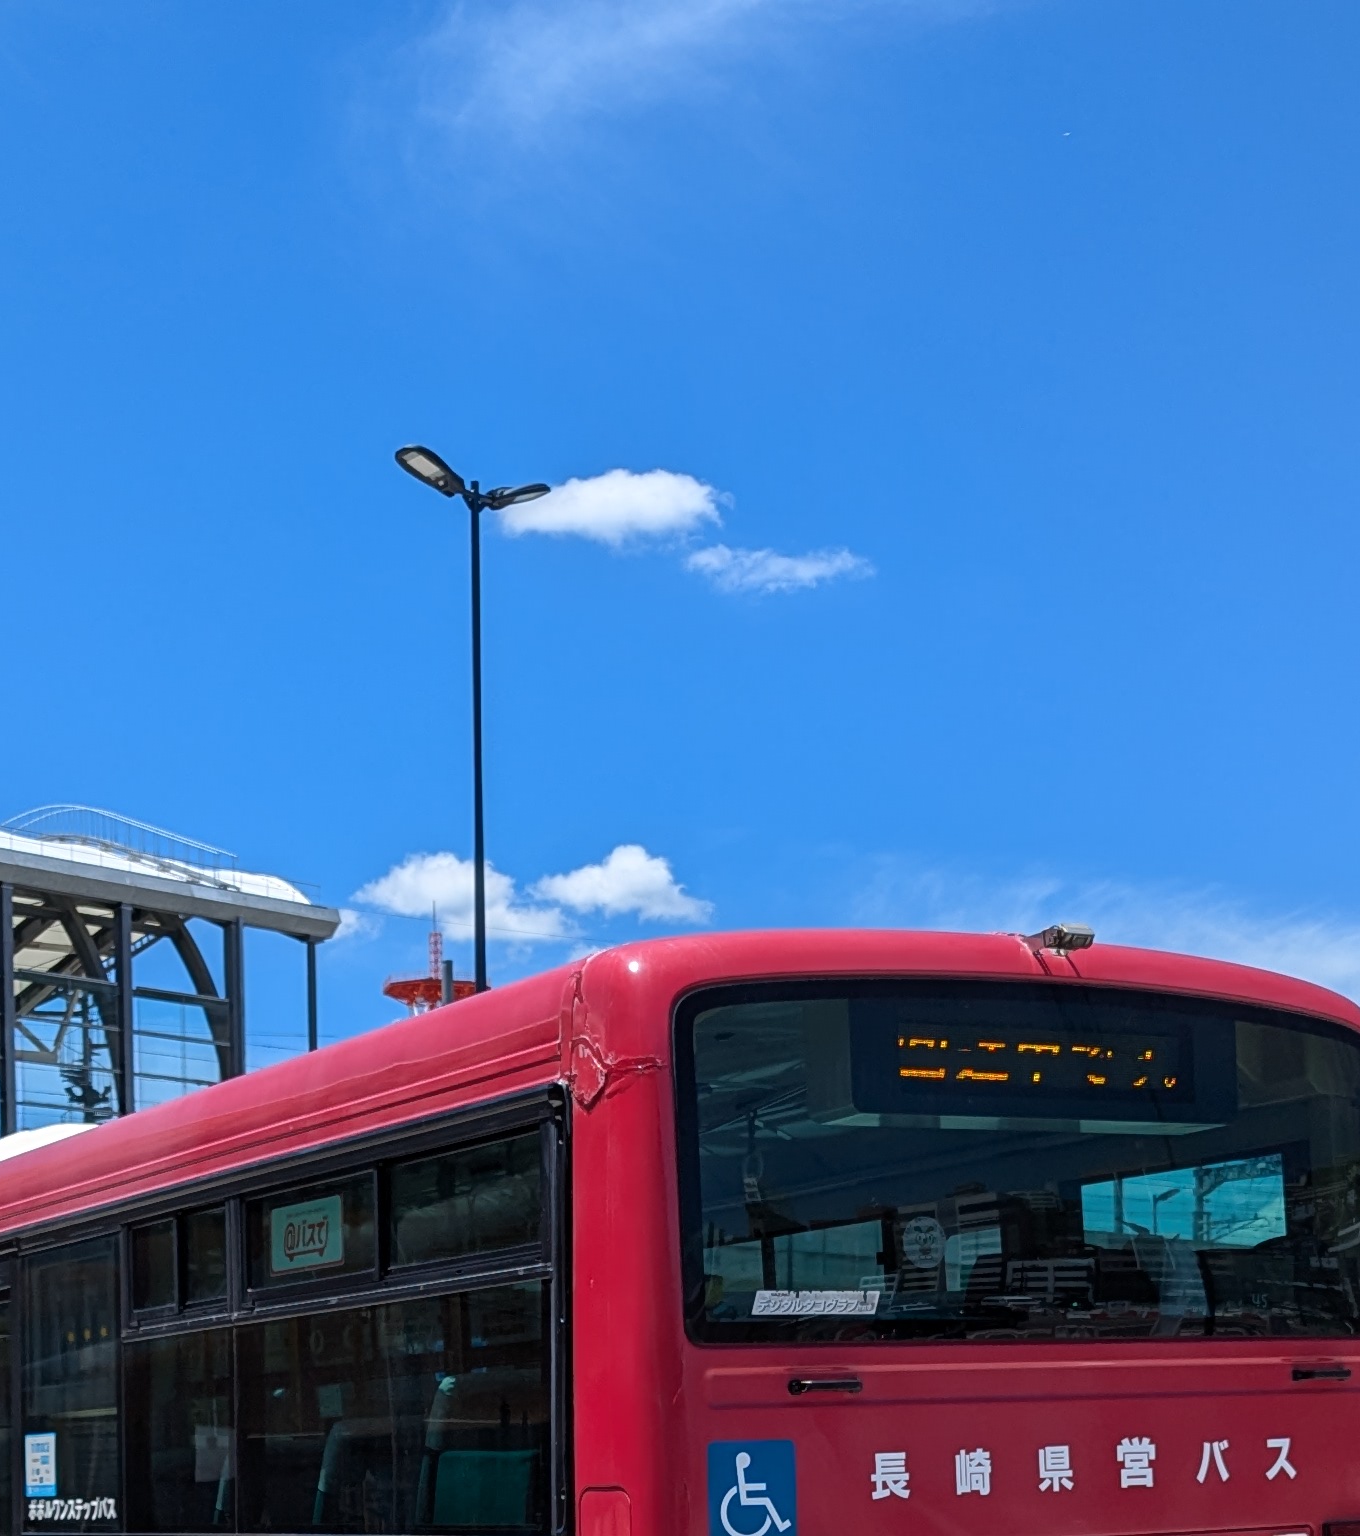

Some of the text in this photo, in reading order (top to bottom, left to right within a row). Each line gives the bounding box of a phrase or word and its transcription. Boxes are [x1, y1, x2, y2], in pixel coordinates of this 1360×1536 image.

[871, 1436, 1297, 1500] 長崎県営バス
